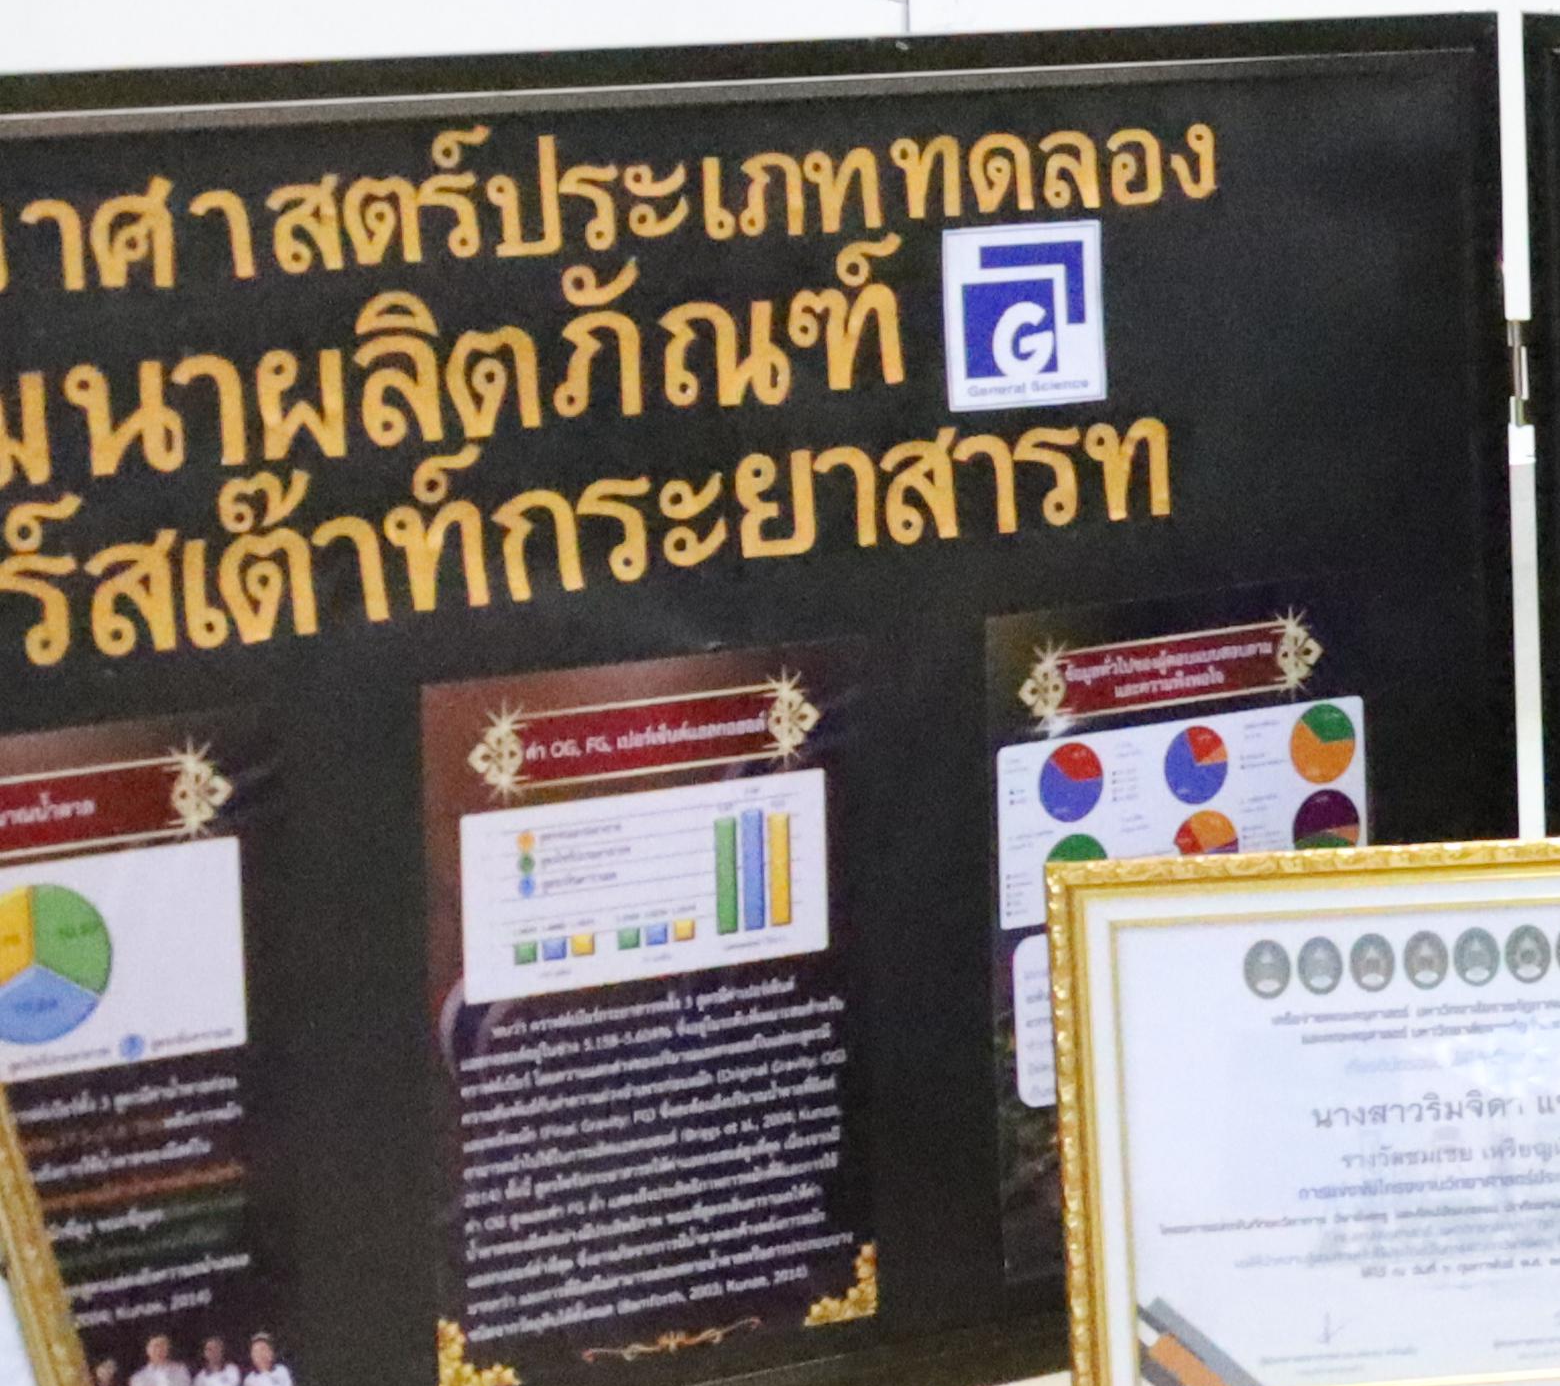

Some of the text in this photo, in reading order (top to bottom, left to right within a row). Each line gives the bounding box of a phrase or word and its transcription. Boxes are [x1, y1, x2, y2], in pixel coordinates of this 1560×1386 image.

[0, 123, 1218, 295] าศาสตร์ประเภททดลอง
[966, 376, 1090, 400] General Science
